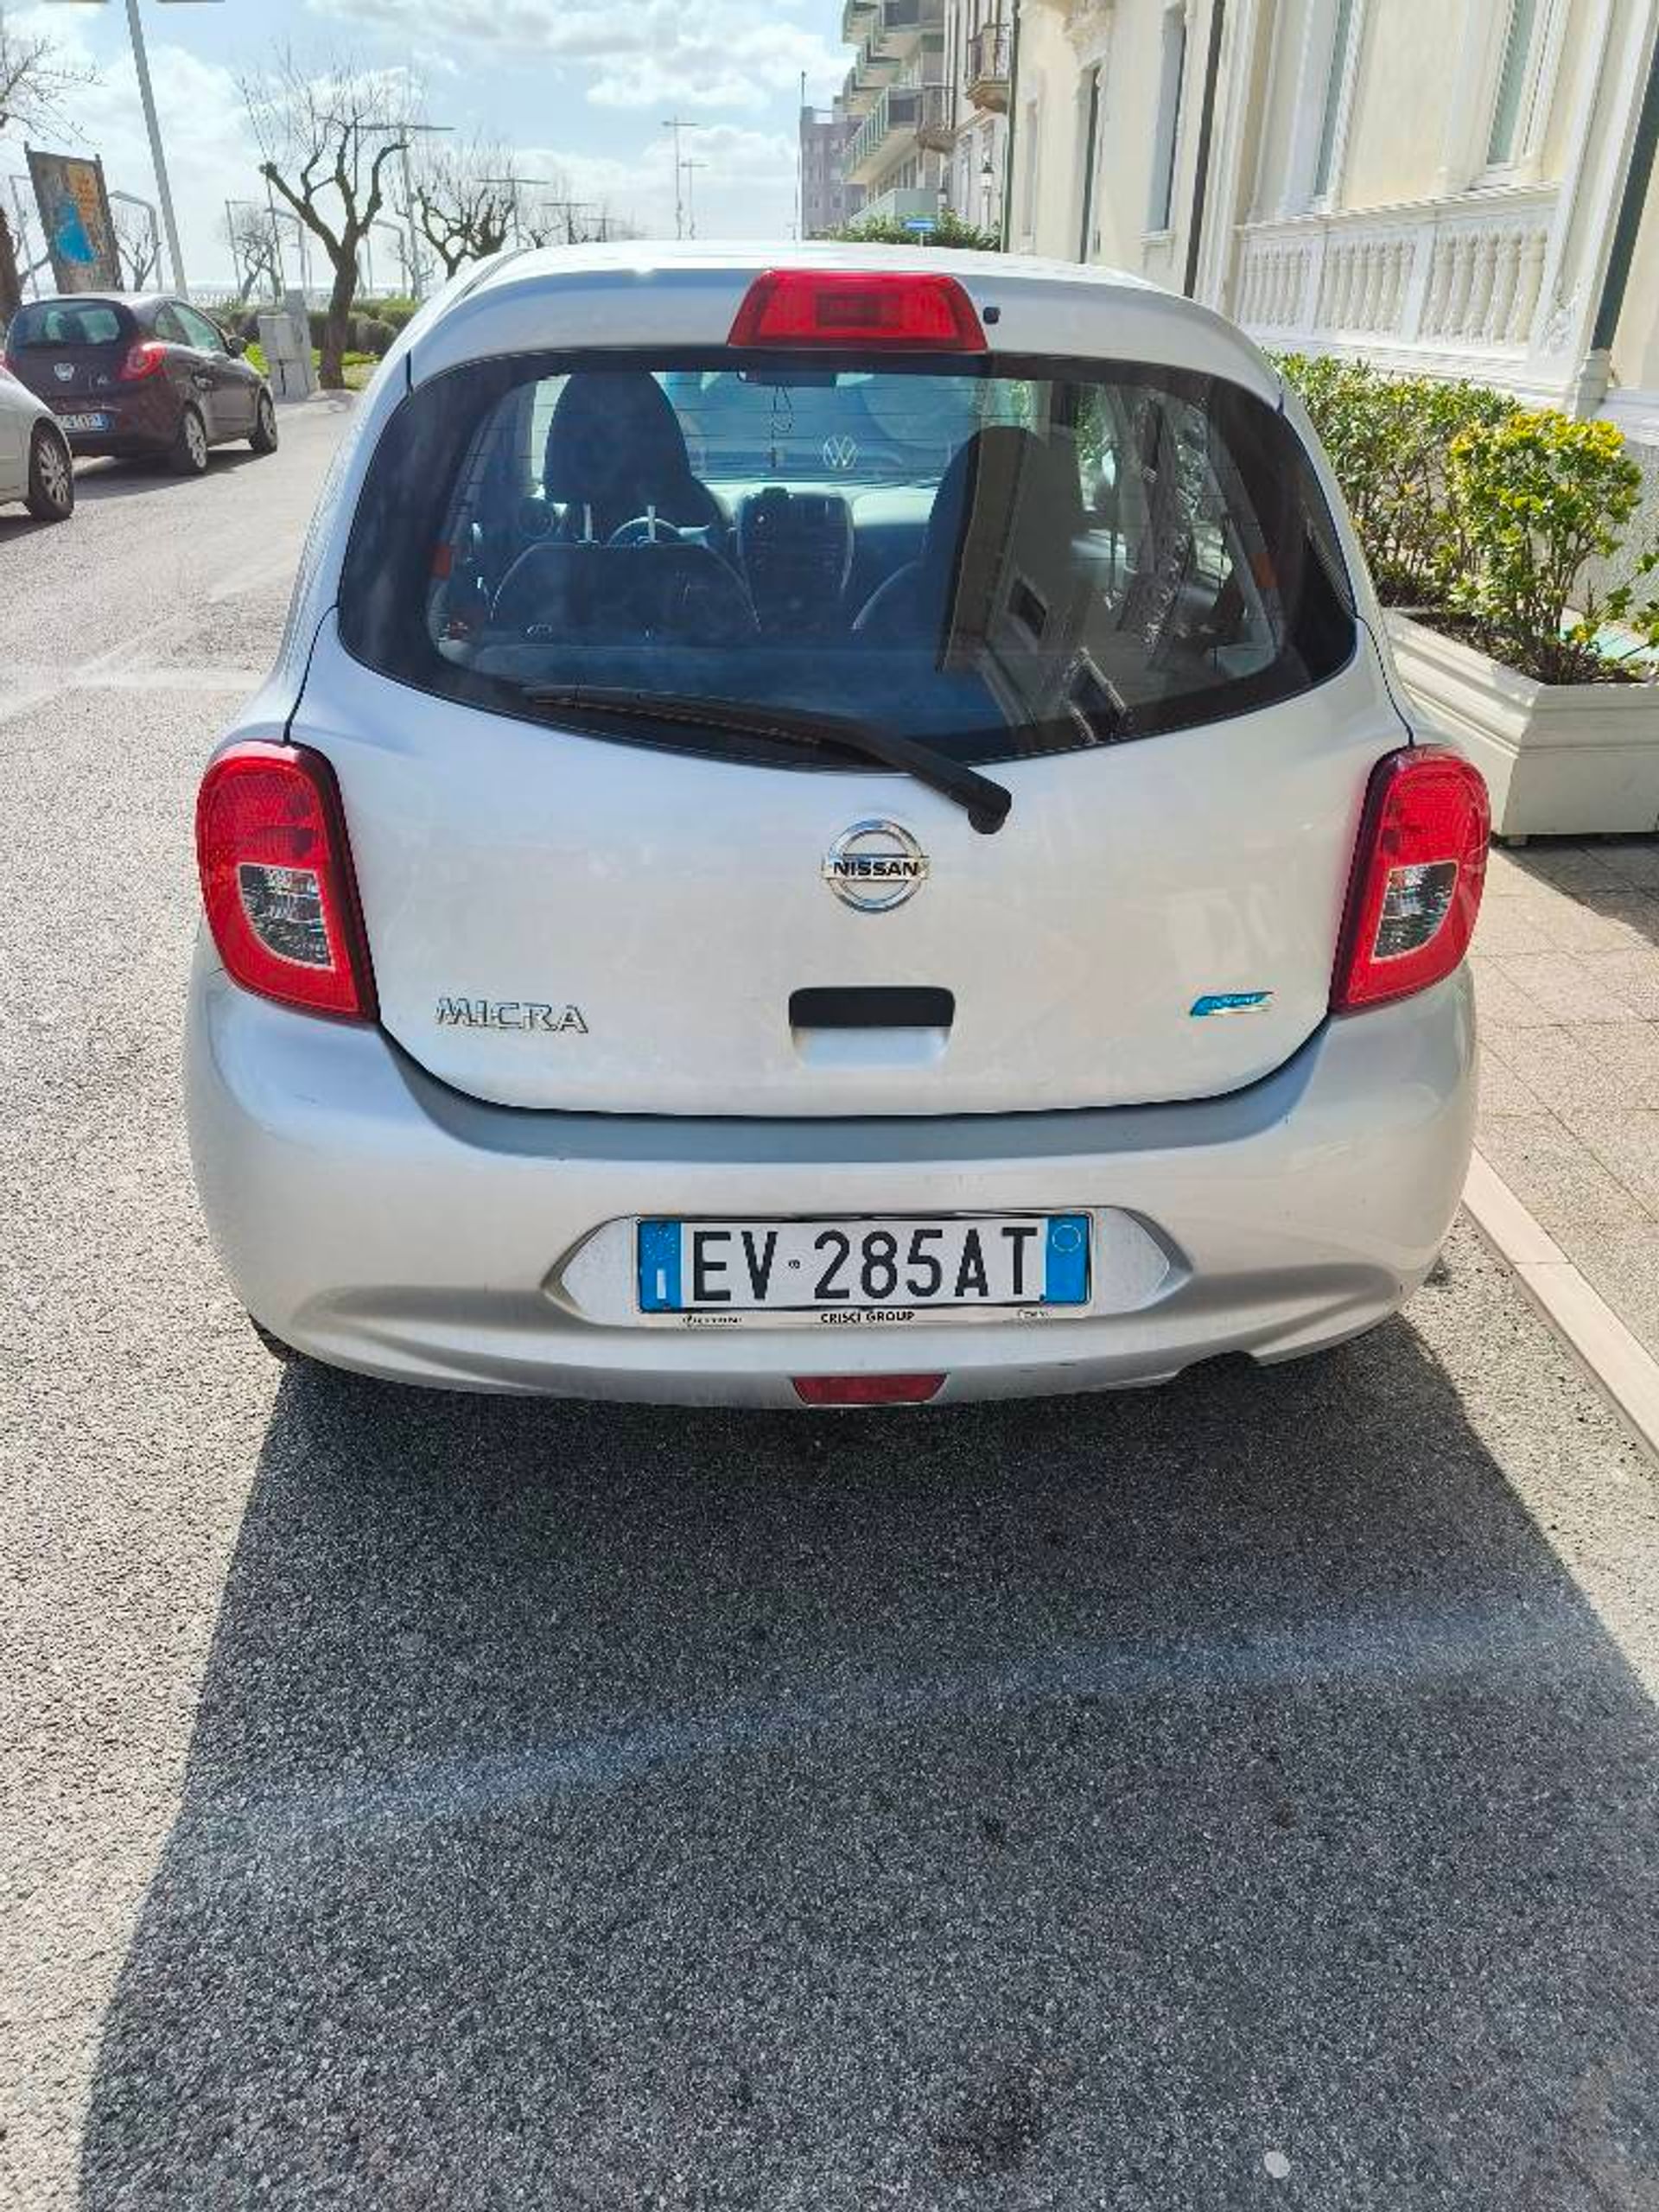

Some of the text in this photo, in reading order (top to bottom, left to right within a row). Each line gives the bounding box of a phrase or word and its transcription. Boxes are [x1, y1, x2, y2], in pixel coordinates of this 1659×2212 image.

[833, 861, 918, 876] NISSAN
[435, 997, 589, 1034] MICRA
[693, 1226, 1039, 1301] EV 285AT
[820, 1311, 916, 1324] CRISCI GROUP
